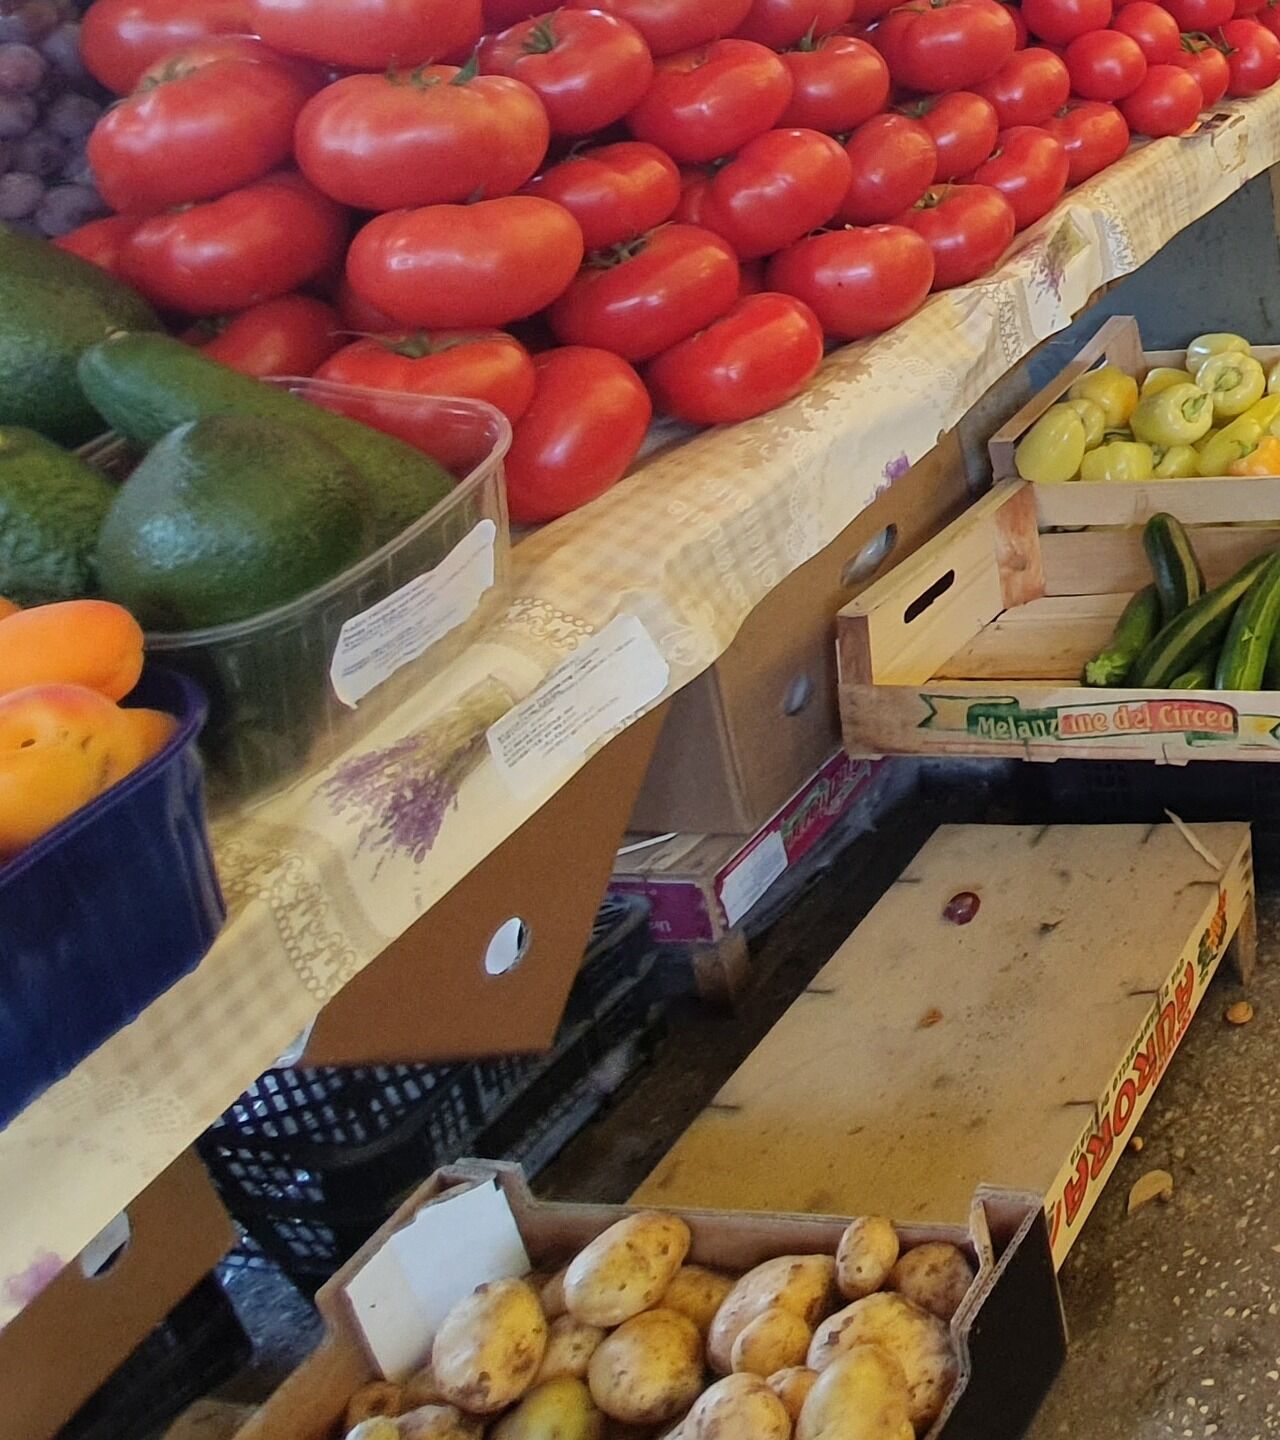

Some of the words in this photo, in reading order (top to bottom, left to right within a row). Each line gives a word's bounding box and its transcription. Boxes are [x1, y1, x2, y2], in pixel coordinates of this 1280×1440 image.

[1115, 704, 1153, 729] del
[1158, 704, 1236, 732] Circeo
[1063, 960, 1196, 1228] AURORA
